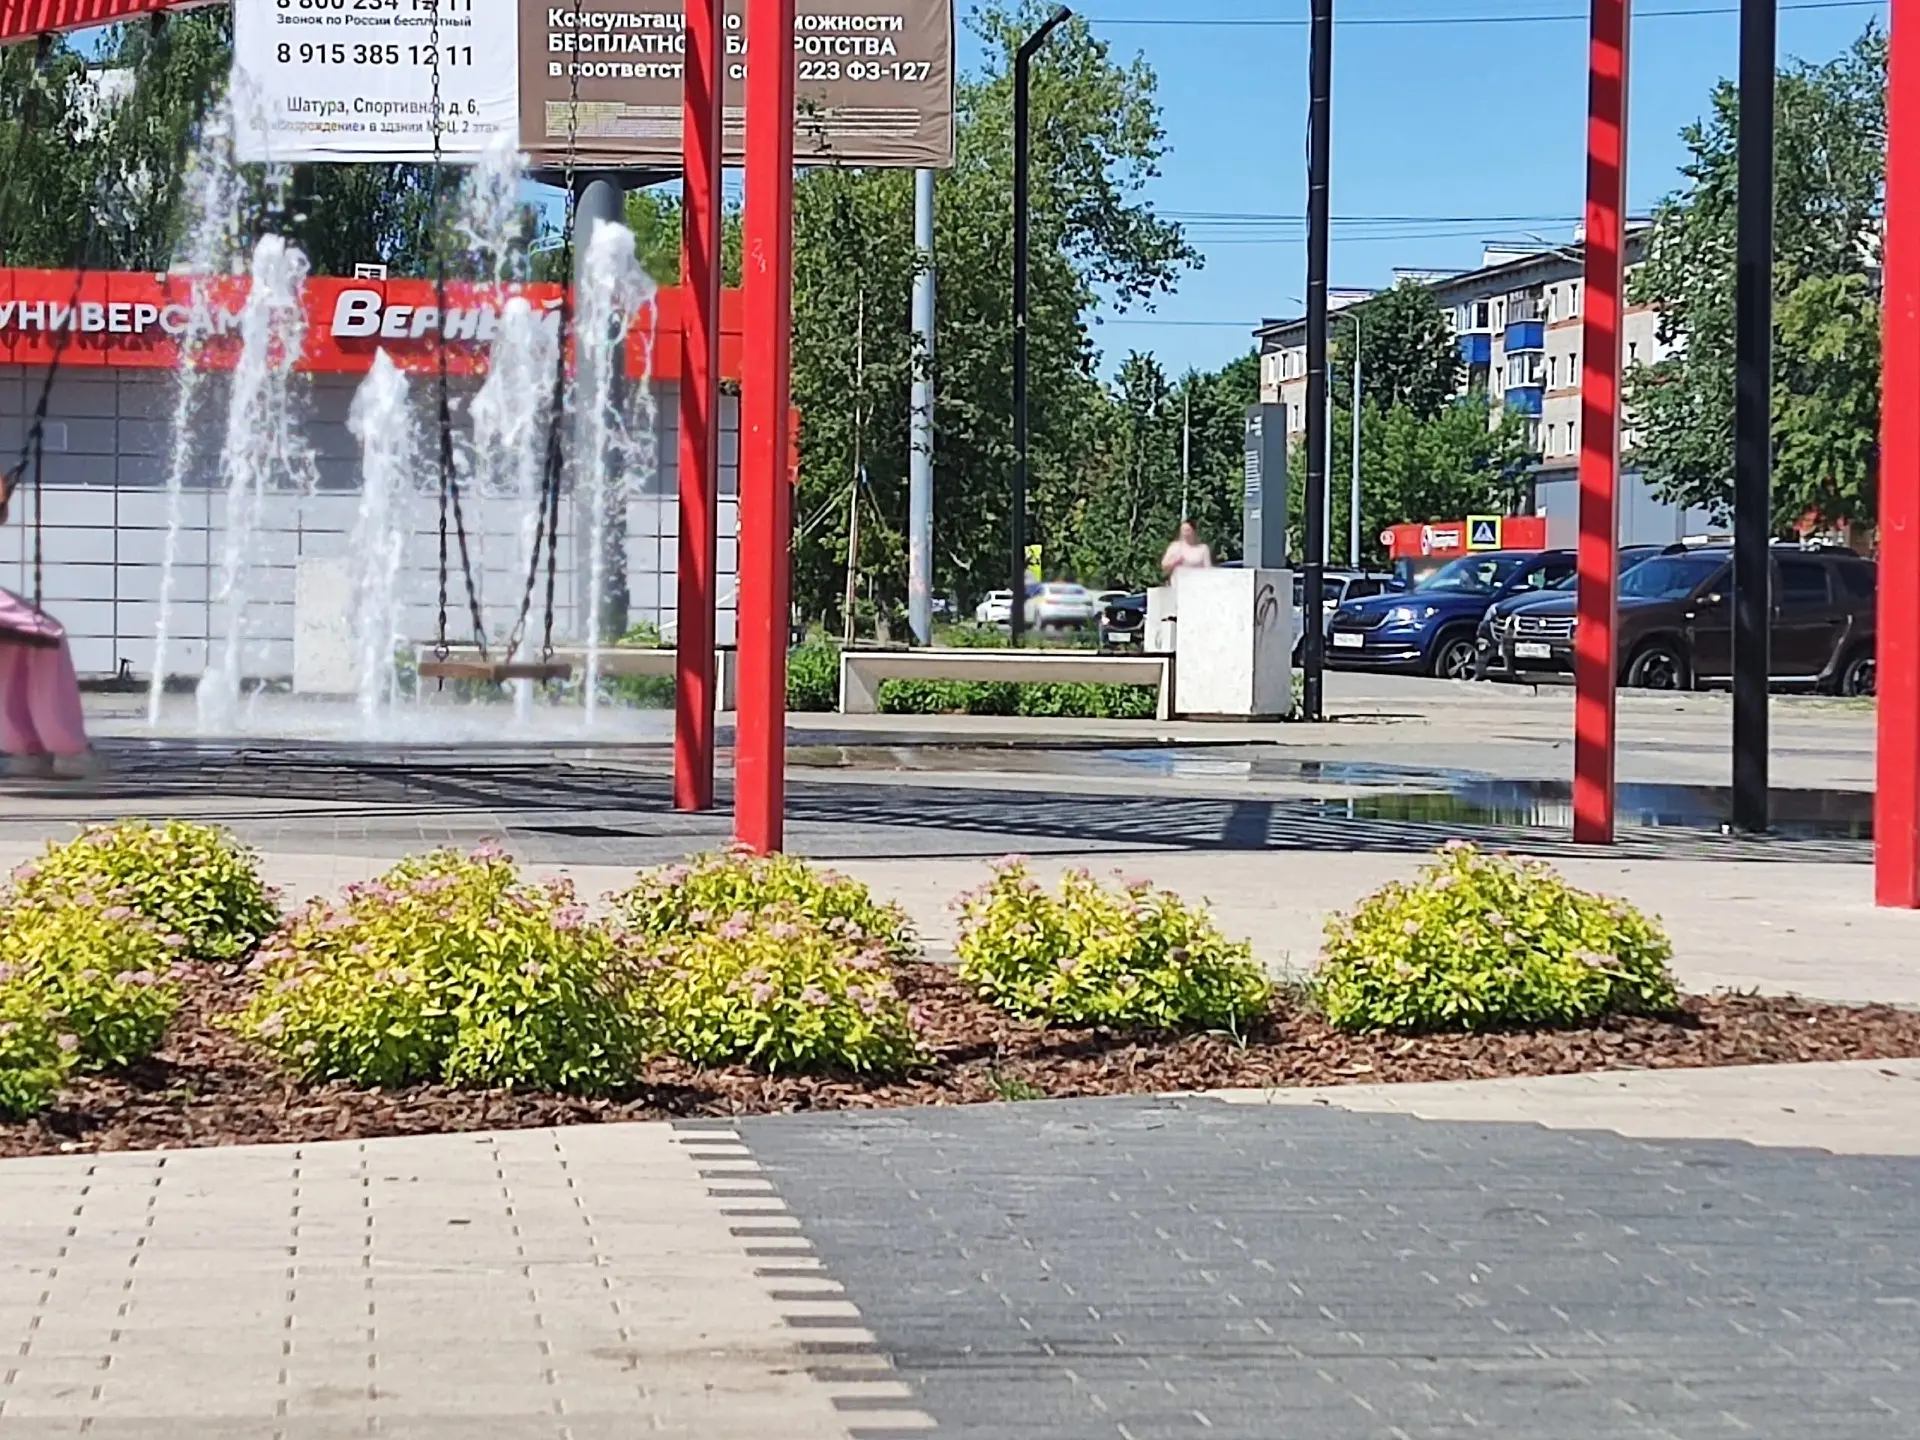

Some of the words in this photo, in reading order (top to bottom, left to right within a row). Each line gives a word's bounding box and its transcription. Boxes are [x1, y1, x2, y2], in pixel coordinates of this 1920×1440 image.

[276, 13, 323, 25] Звонок
[326, 15, 342, 25] по
[345, 14, 391, 27] России
[548, 33, 686, 53] БЕСПЛАТНО
[277, 43, 291, 64] 8
[299, 43, 345, 65] 915
[353, 44, 399, 65] 385
[408, 45, 439, 66] 12
[447, 45, 472, 67] 11
[549, 62, 563, 77] в
[799, 61, 840, 81] 223
[846, 61, 931, 82] ФЗ-127
[287, 96, 350, 117] Шатура,
[449, 102, 463, 116] д.
[467, 98, 481, 116] 6,
